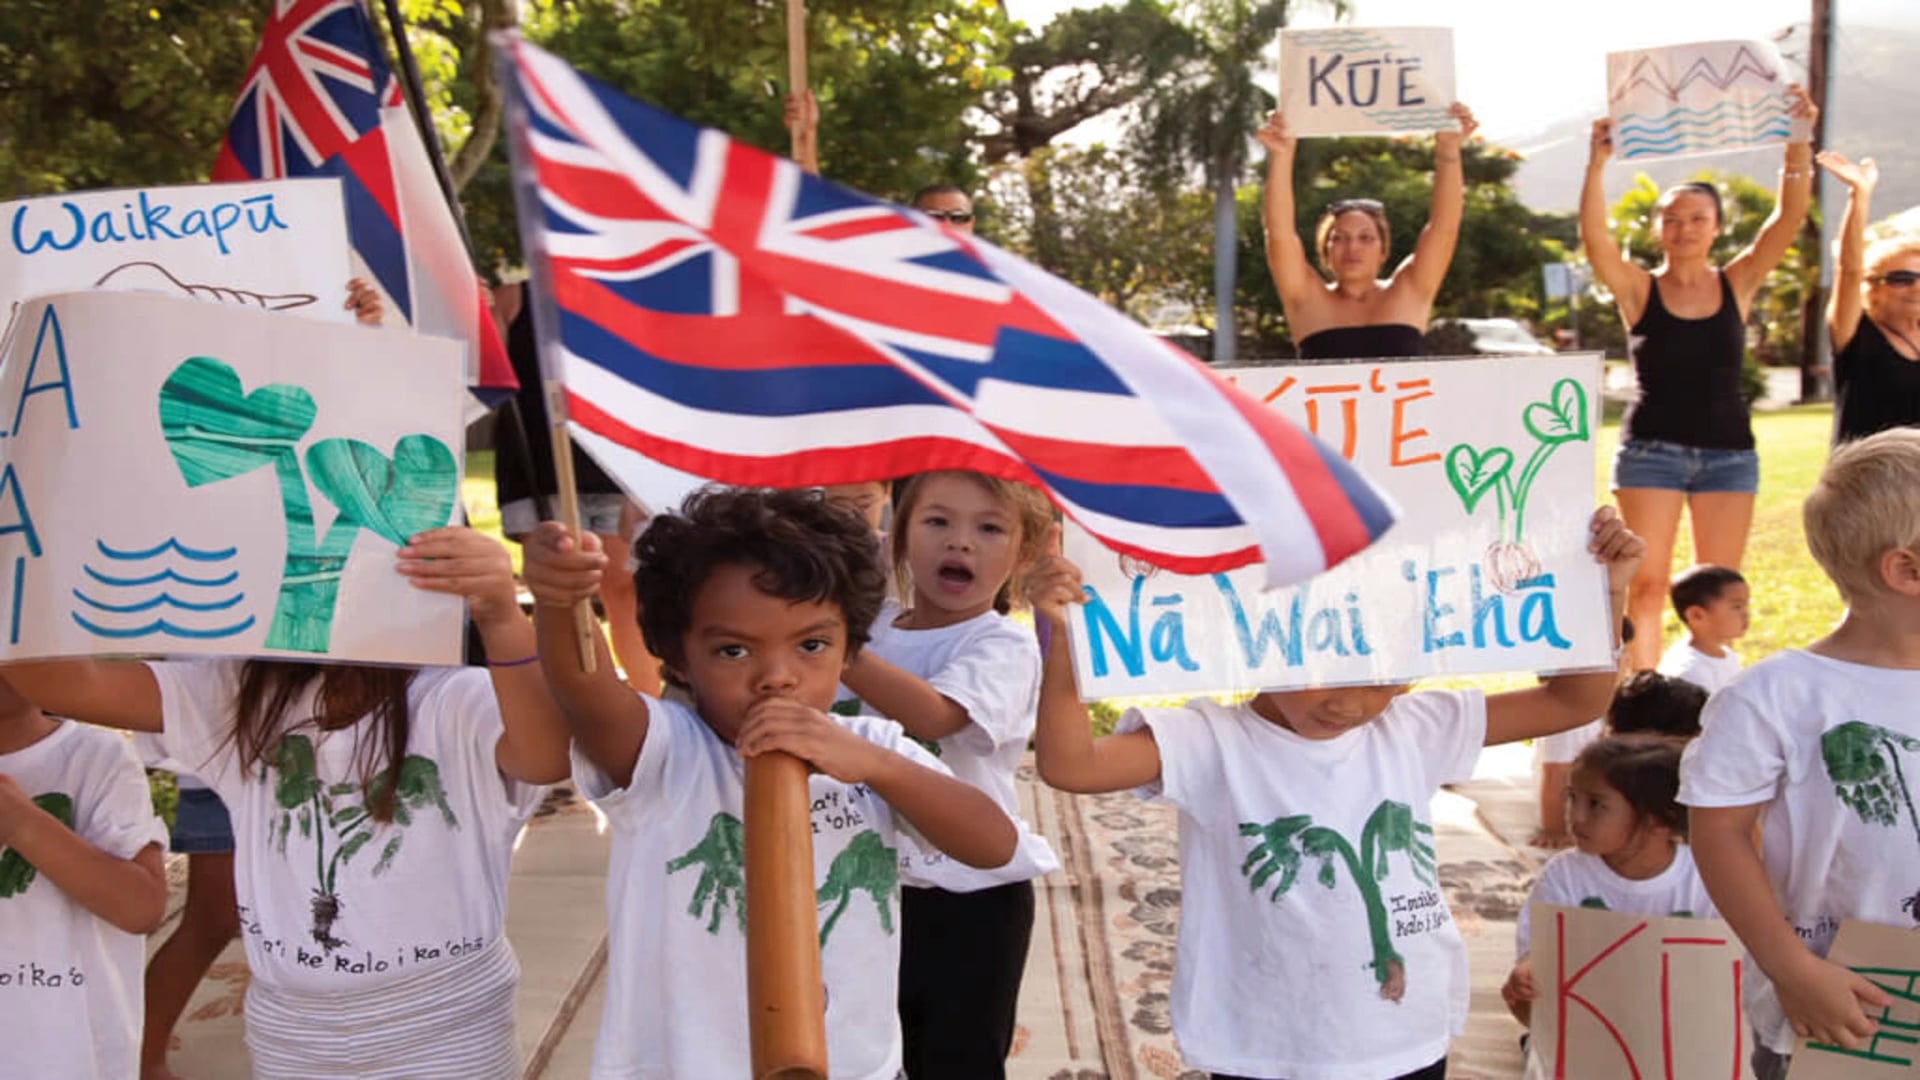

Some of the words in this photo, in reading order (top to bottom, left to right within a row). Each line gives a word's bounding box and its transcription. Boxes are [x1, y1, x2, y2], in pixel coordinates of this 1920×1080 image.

[11, 191, 288, 254] Waikapū
[1082, 574, 1199, 677] Nā
[1212, 573, 1372, 668] Wai
